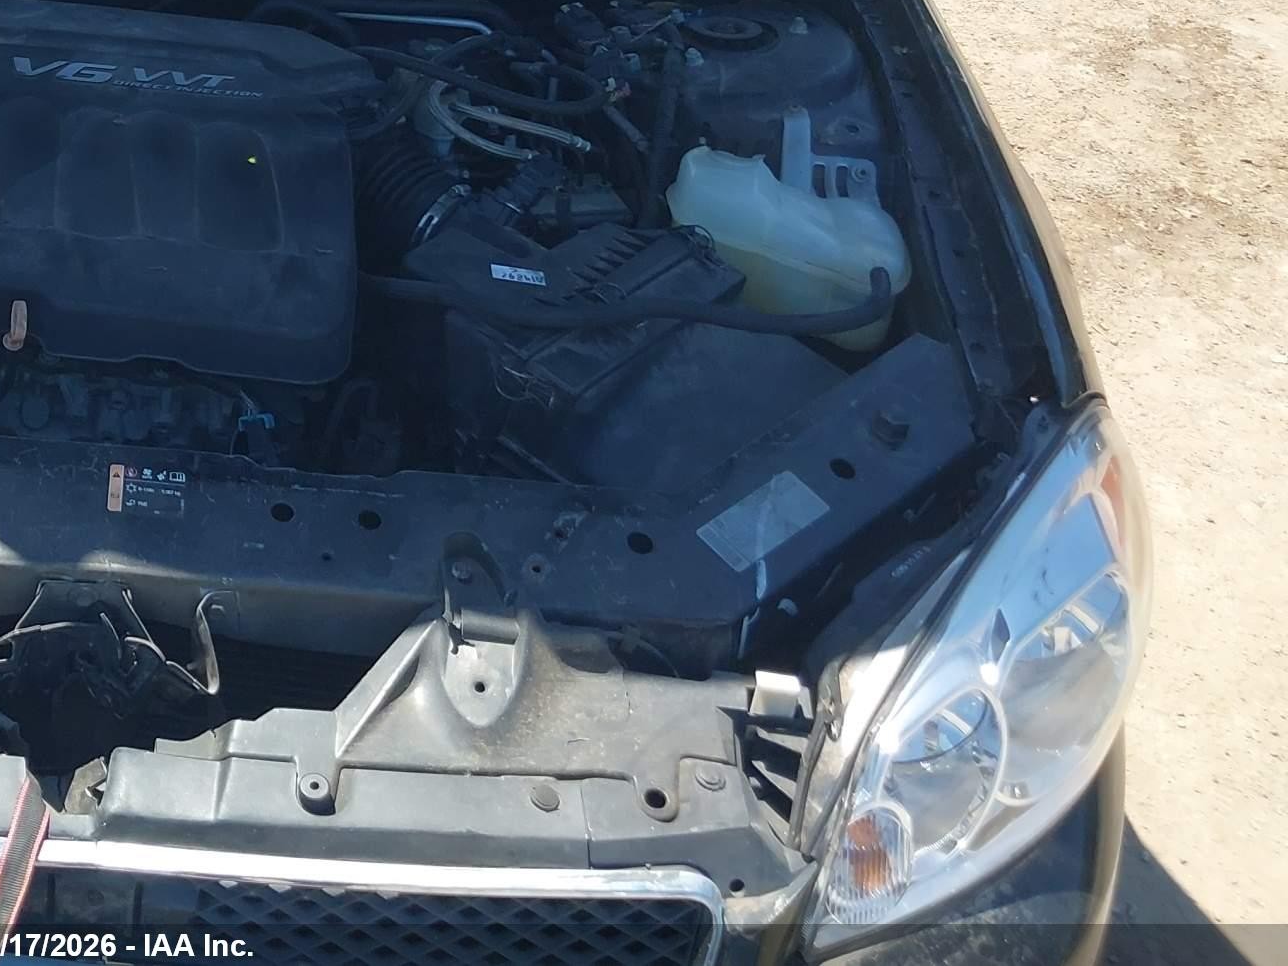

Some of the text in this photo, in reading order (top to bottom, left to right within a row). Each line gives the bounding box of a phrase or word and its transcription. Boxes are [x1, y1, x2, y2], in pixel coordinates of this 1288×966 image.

[13, 56, 235, 88] V6 VVT
[113, 80, 263, 98] DIRECT INJECTION
